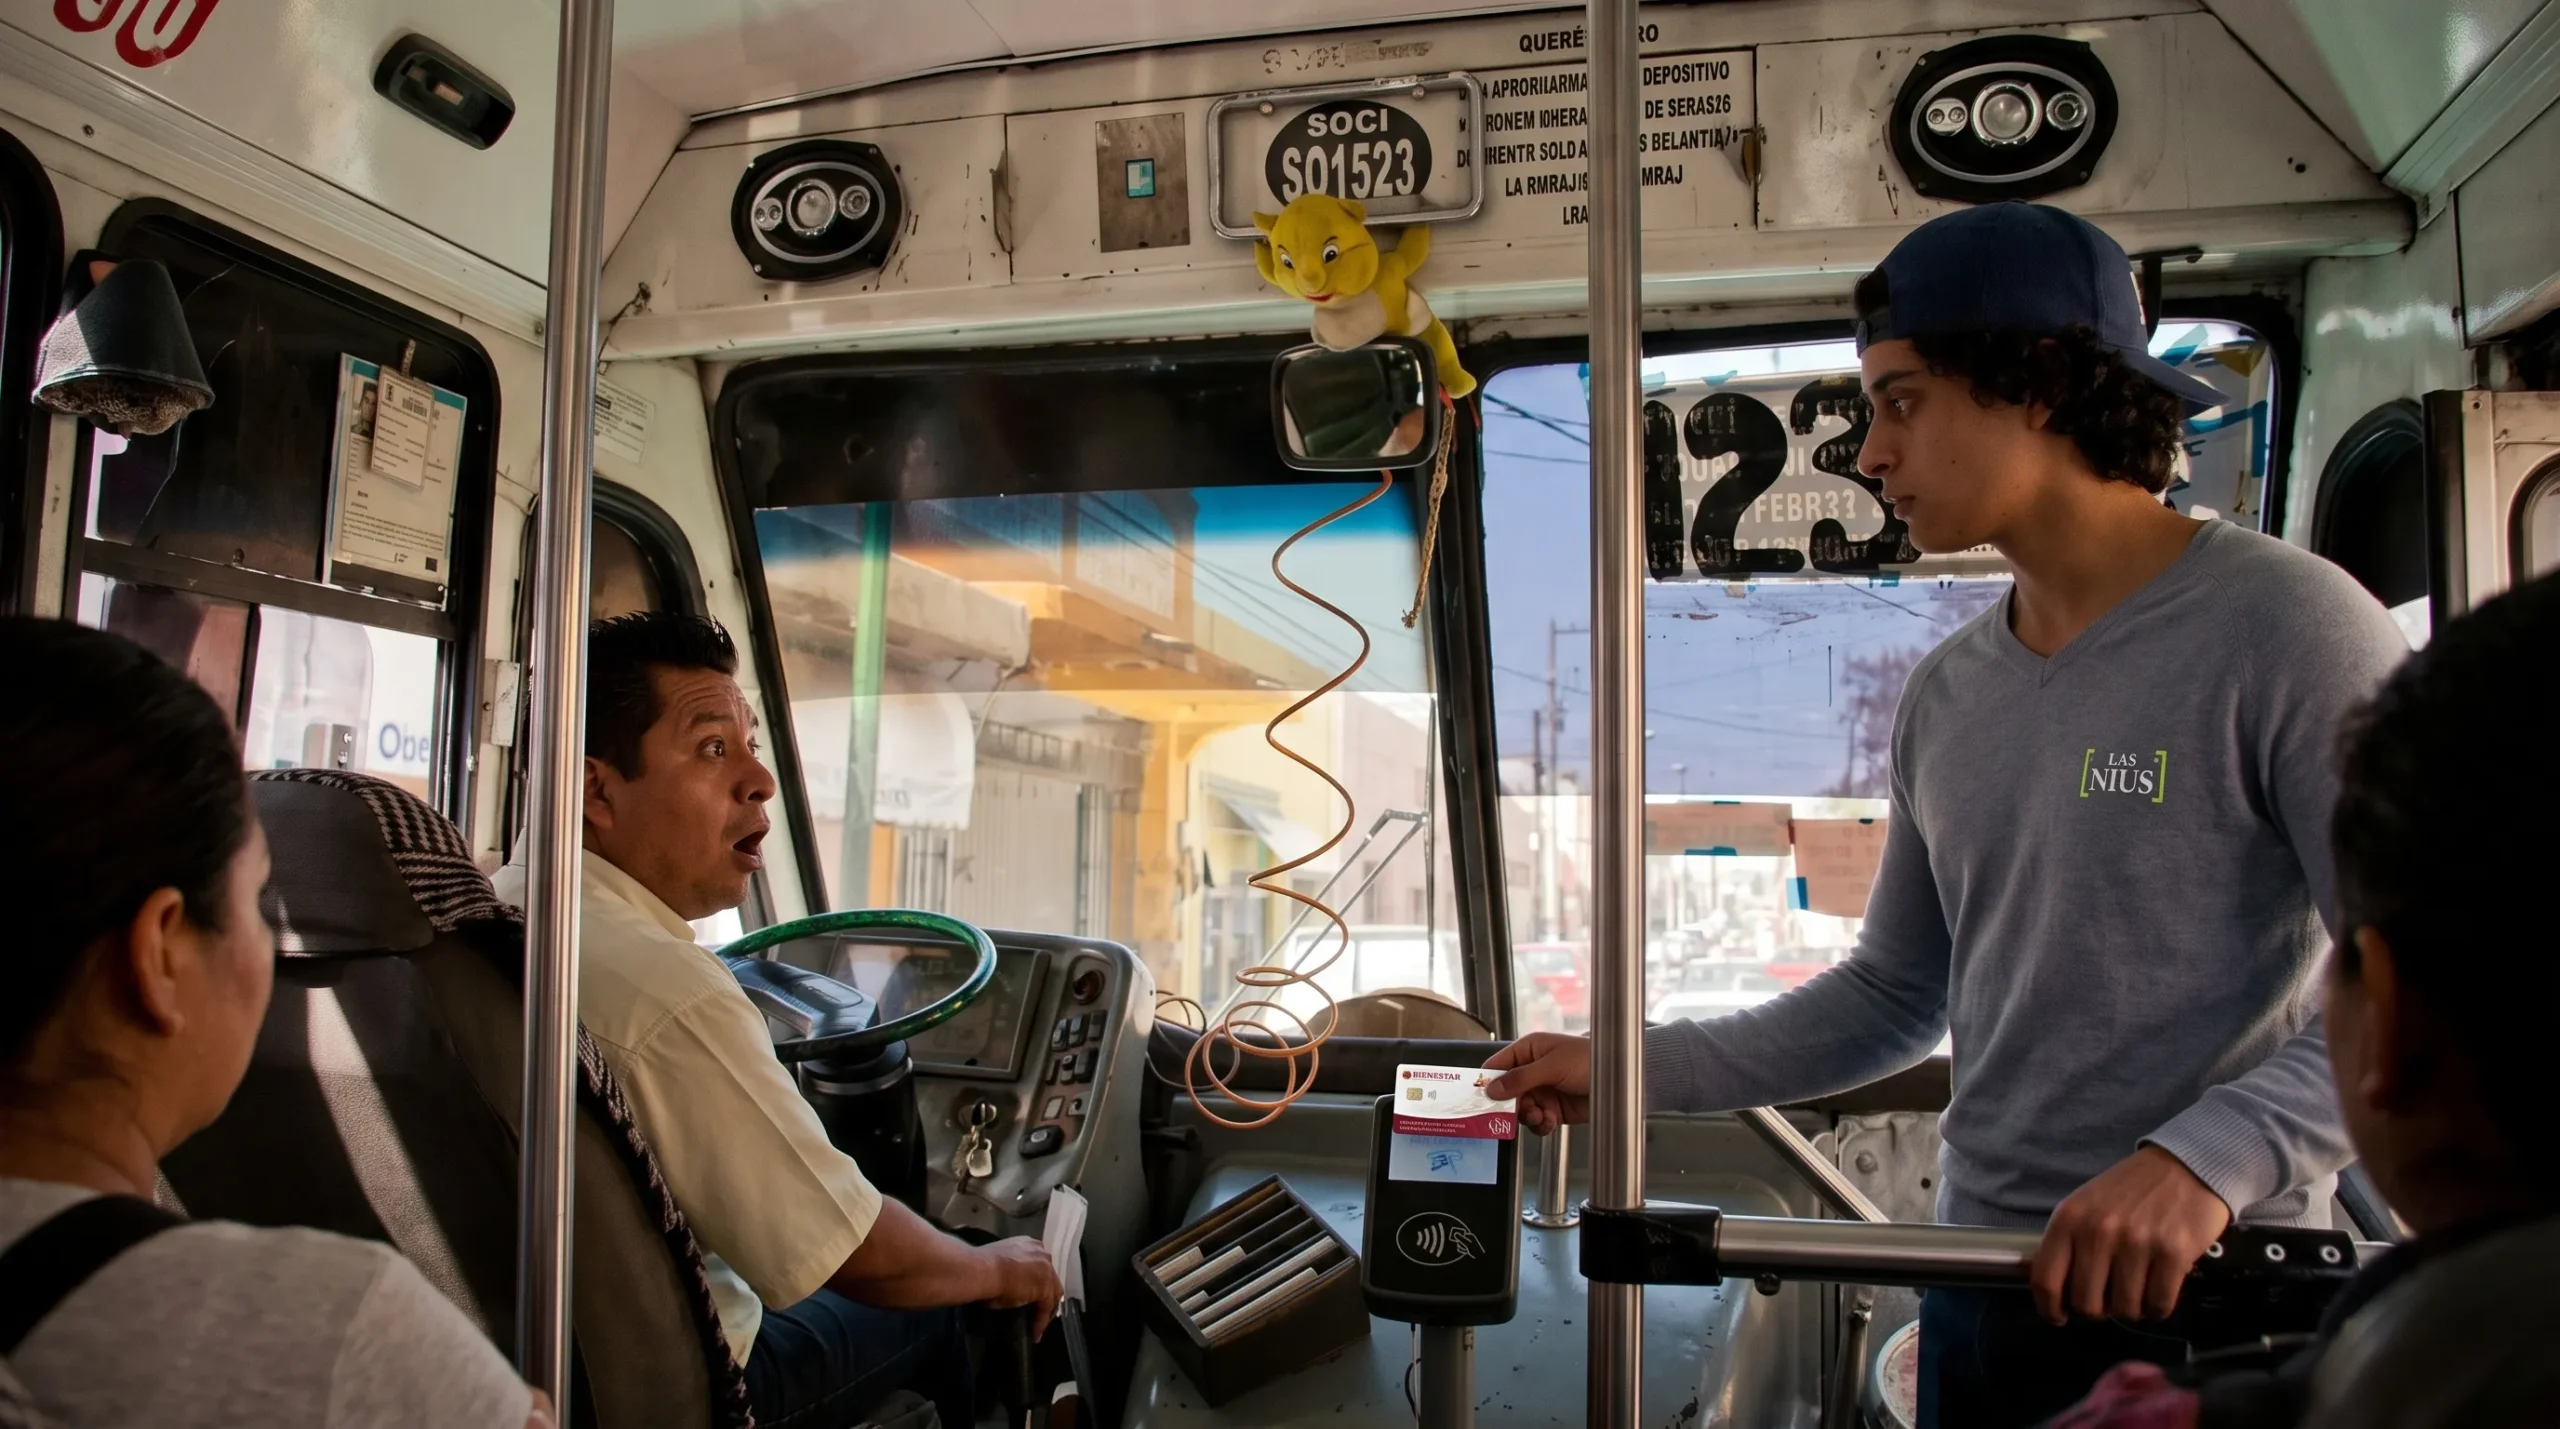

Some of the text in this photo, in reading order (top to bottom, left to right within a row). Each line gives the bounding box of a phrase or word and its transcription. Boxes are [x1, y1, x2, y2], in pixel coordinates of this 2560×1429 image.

[1643, 61, 1729, 86] DEPOSITIVO
[1645, 94, 1731, 119] DE SERAS26
[1307, 108, 1388, 137] SOCI
[1505, 177, 1523, 197] LA
[1643, 377, 1922, 583] 123
[2108, 752, 2137, 767] LAS
[2088, 767, 2154, 795] NIUS
[1412, 1071, 1461, 1081] BIENESTAR
